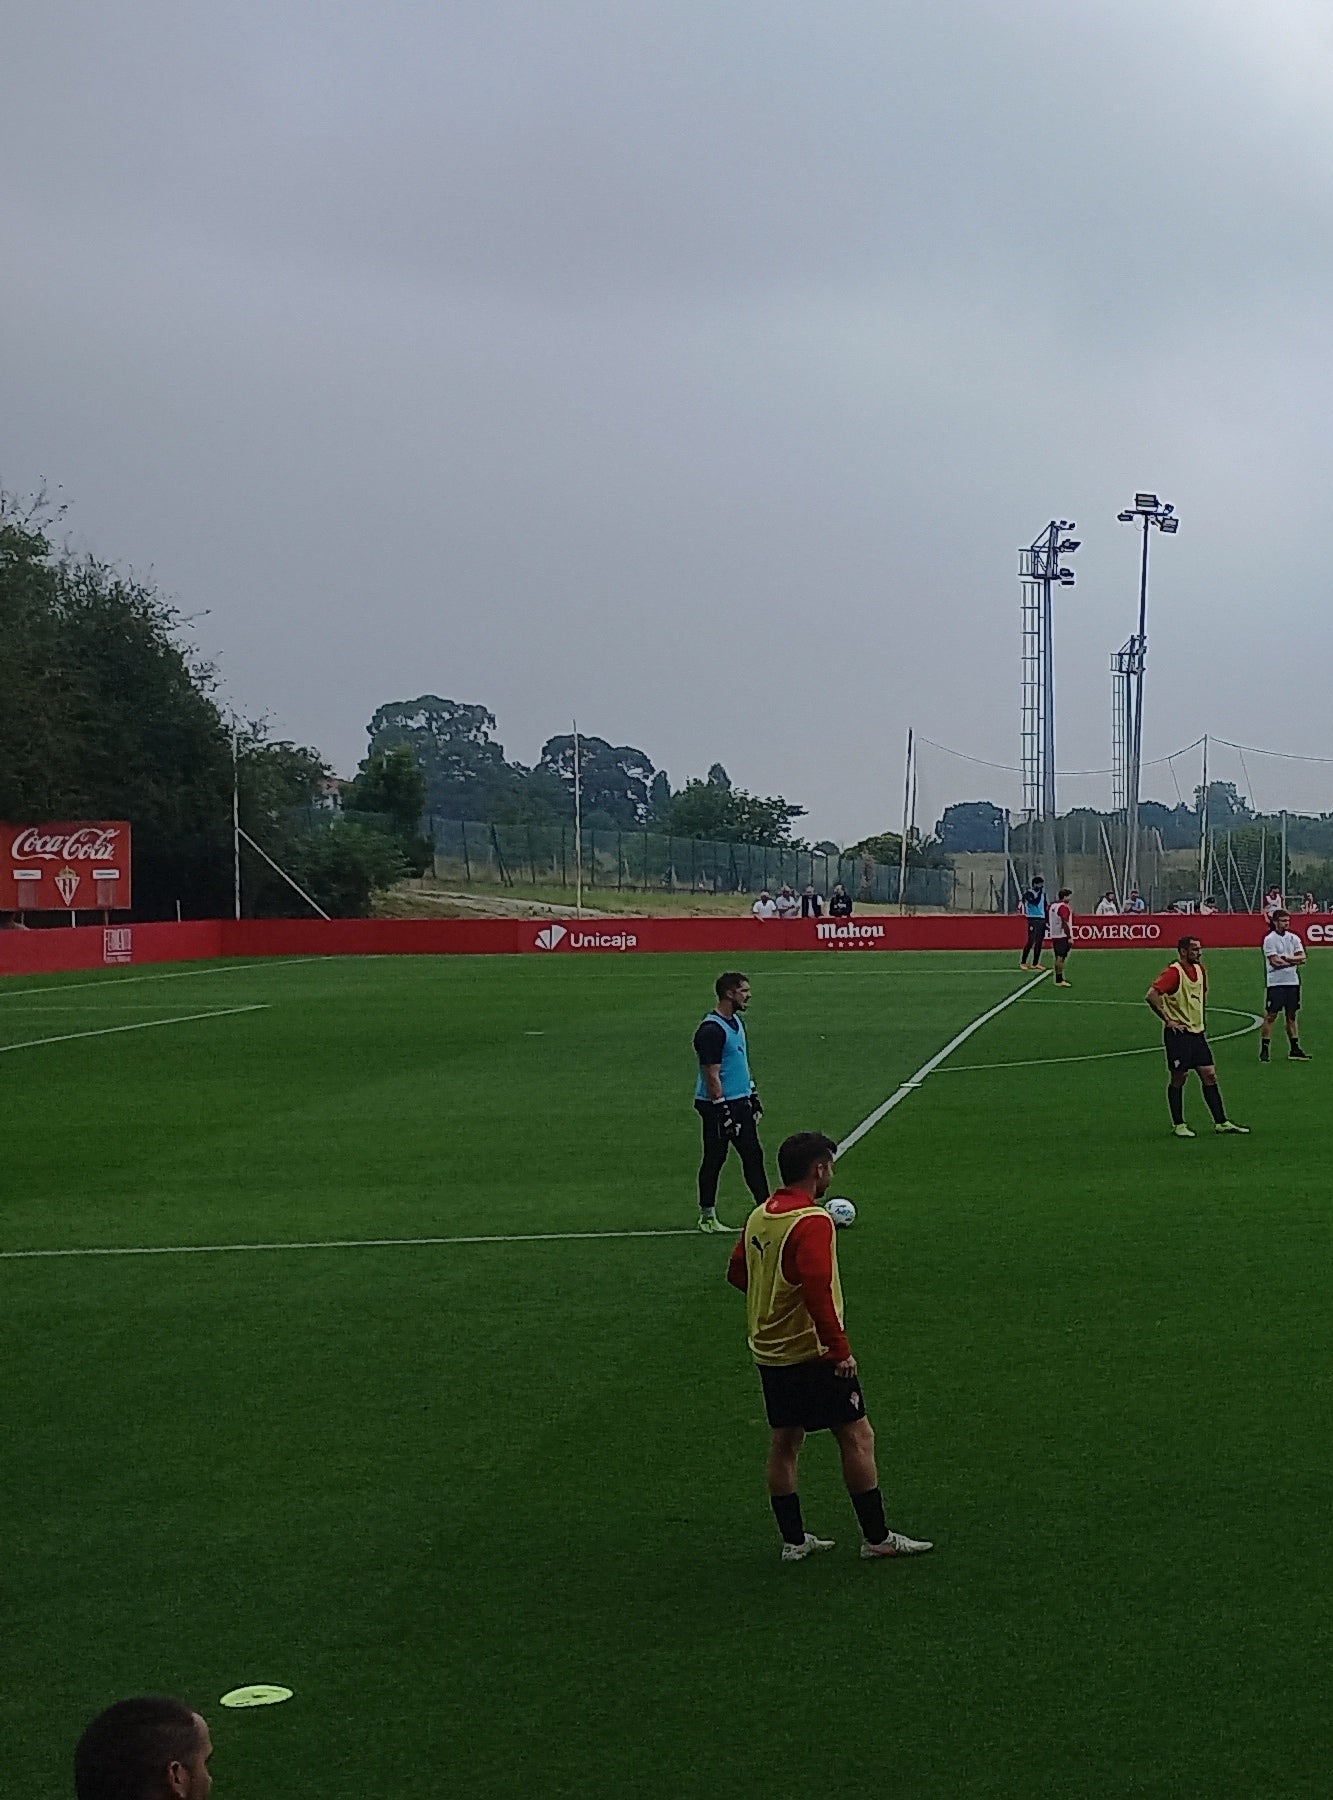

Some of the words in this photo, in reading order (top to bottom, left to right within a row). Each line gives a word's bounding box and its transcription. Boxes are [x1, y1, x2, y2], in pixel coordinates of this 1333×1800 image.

[11, 827, 121, 861] Coca-Cola
[815, 921, 886, 940] Mahou
[1071, 924, 1161, 940] COMERCIO
[570, 931, 637, 951] Unicaja
